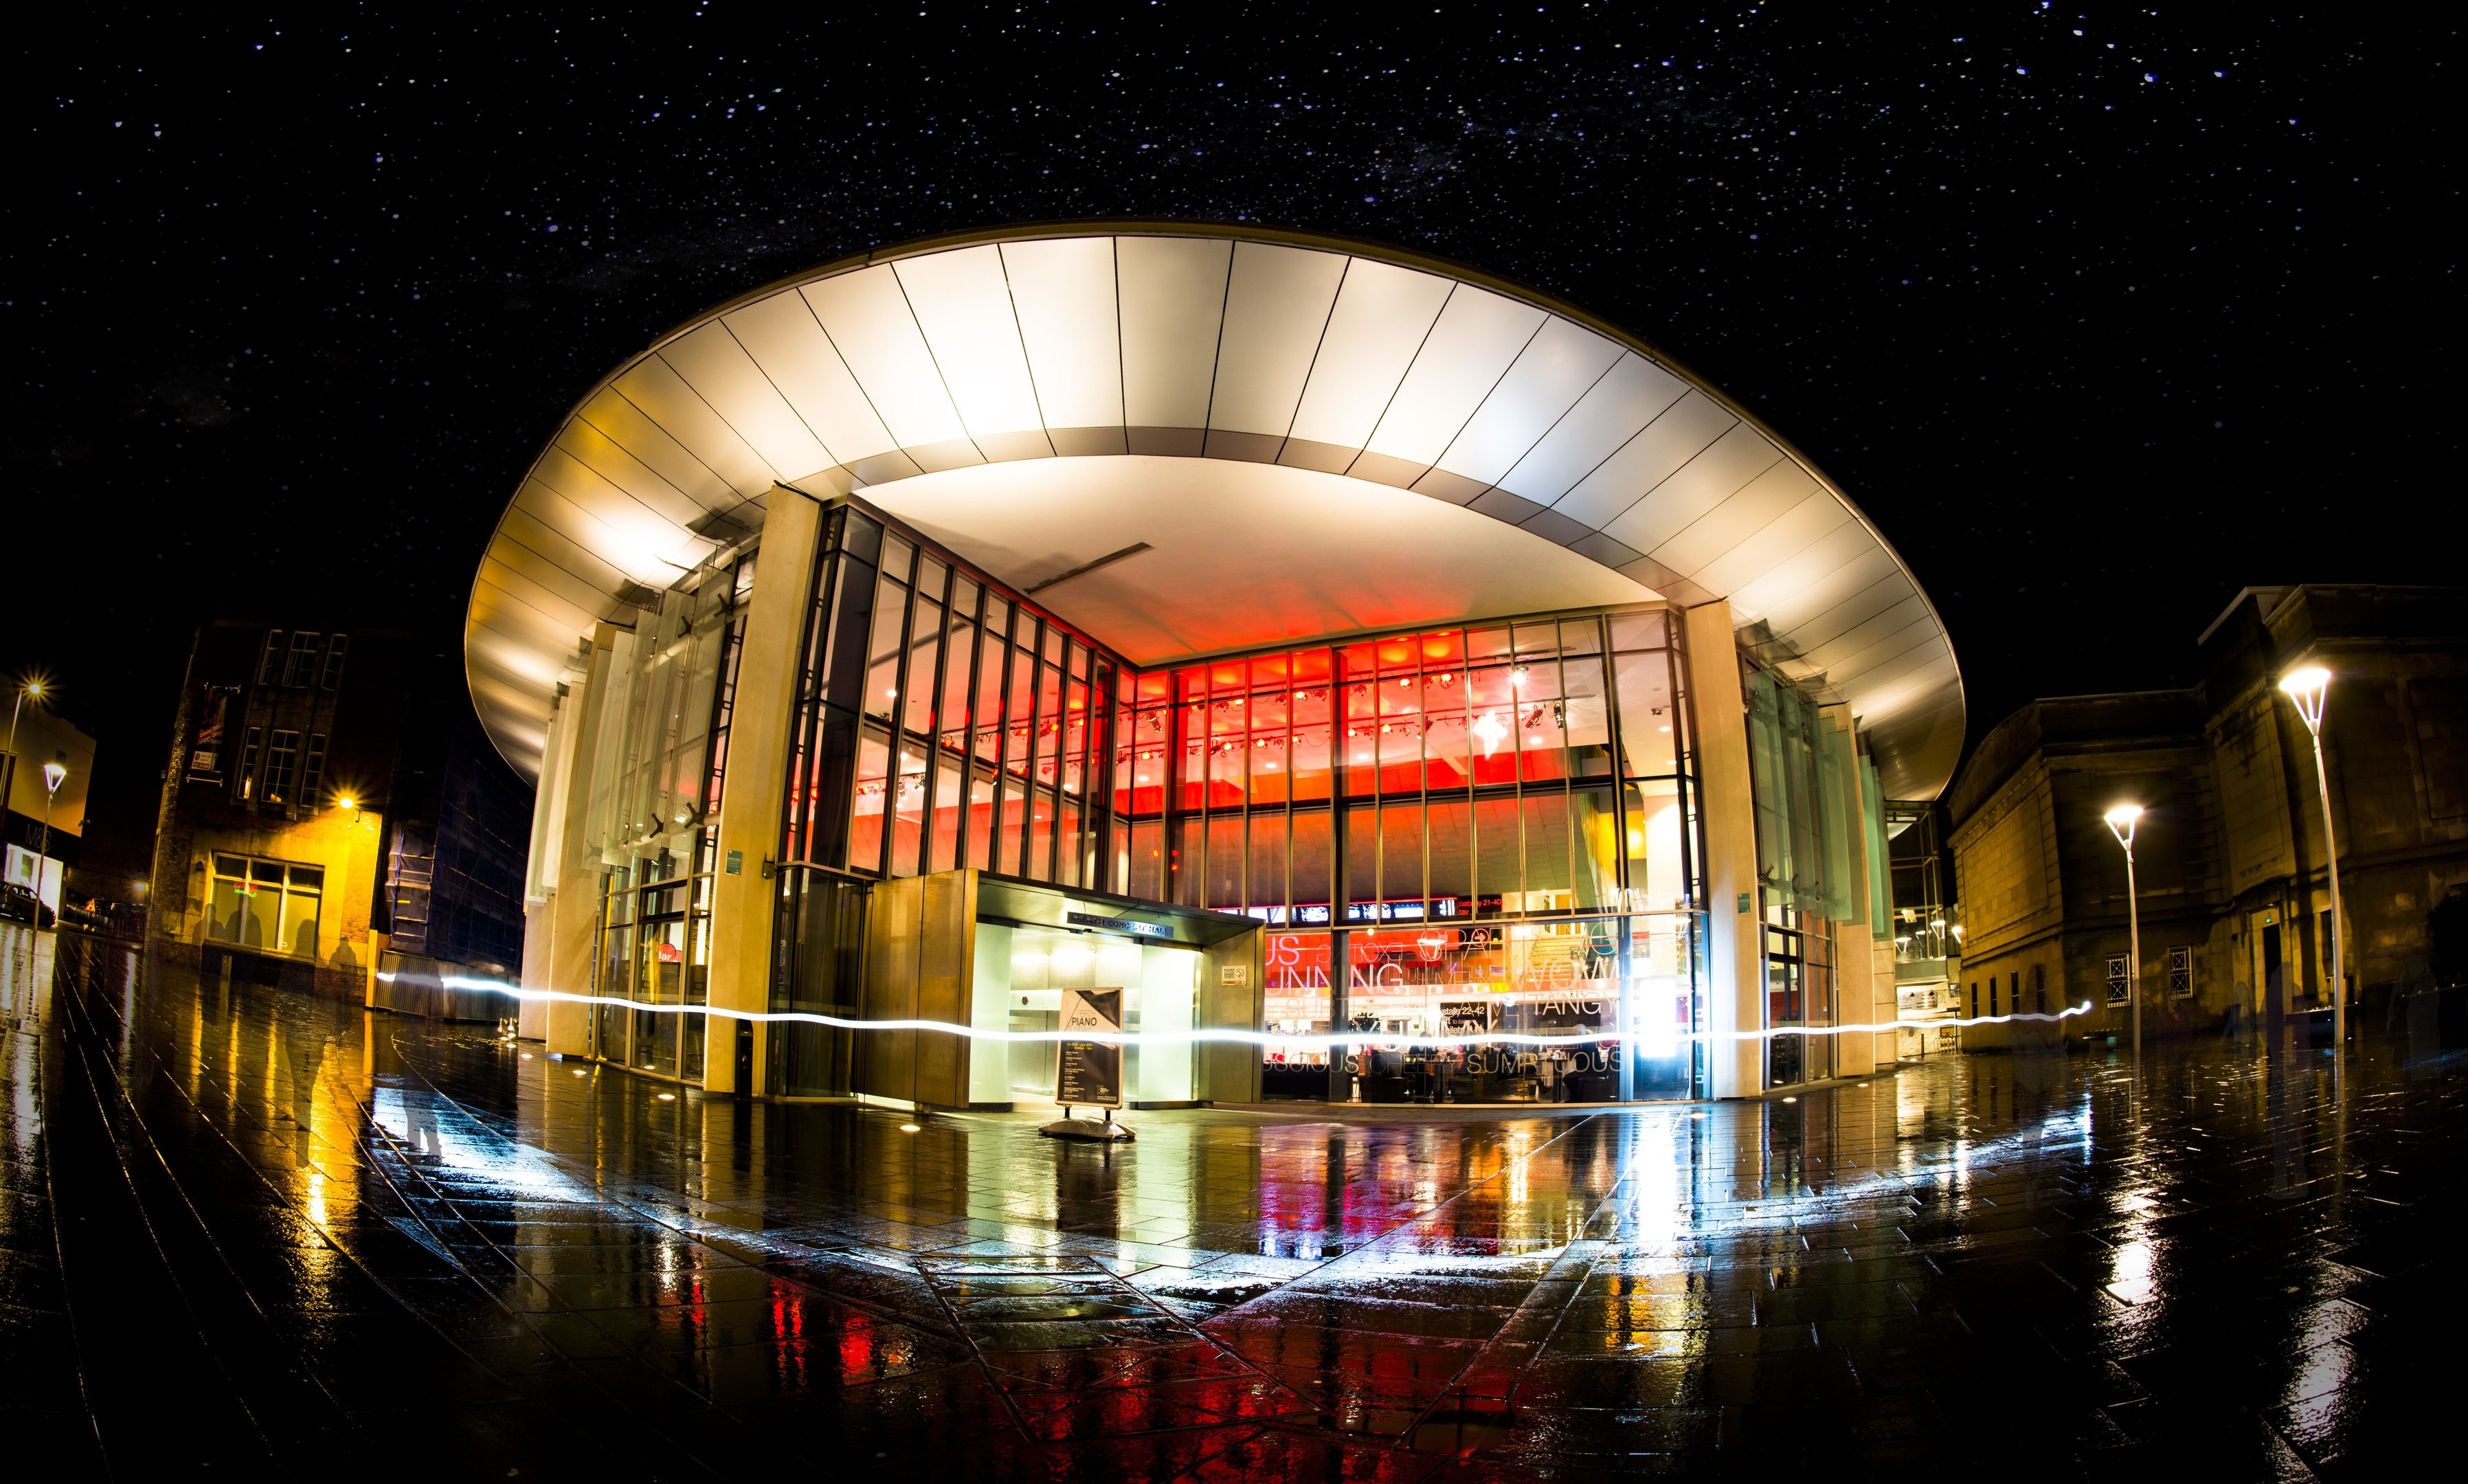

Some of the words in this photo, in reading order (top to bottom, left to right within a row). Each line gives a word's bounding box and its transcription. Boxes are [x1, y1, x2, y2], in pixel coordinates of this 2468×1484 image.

[25, 824, 52, 852] M&S
[1073, 914, 1106, 926] PERTH
[1108, 920, 1147, 932] CONCERT
[1149, 925, 1169, 935] HALL
[1441, 1007, 1461, 1015] stalls
[1462, 1007, 1485, 1015] 22-42
[1071, 1017, 1097, 1026] PIANO
